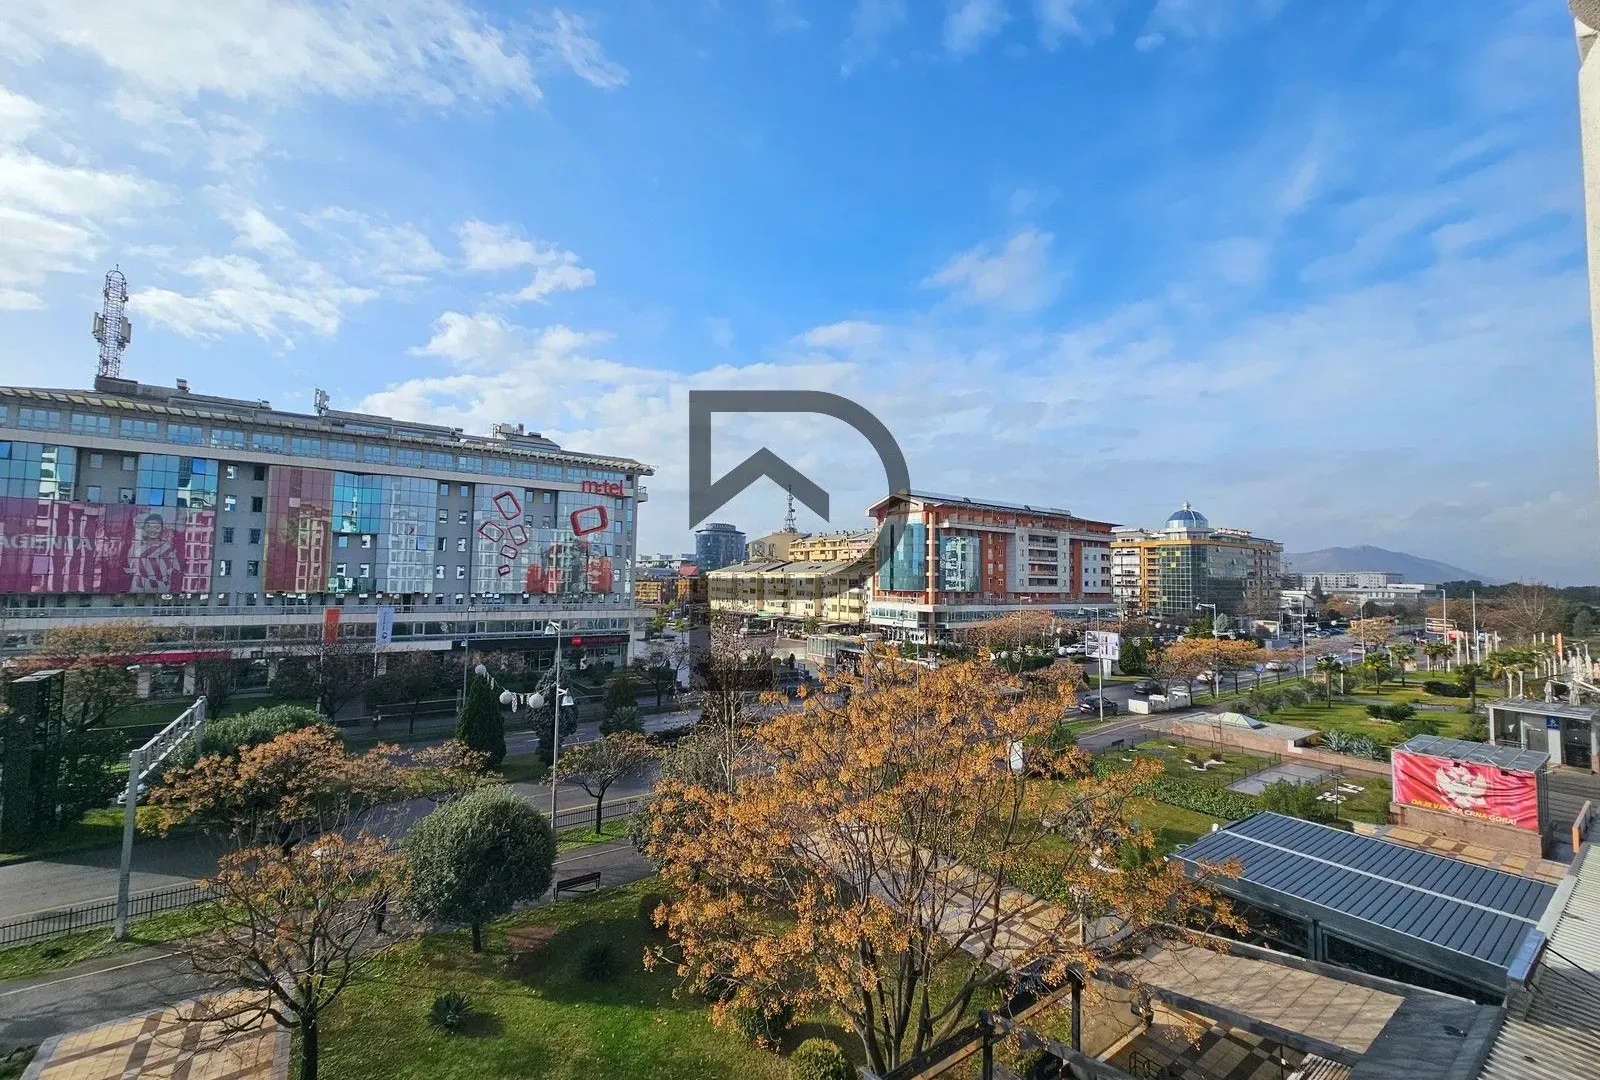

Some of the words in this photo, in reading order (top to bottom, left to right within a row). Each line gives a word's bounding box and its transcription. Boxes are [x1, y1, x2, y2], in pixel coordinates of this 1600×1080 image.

[582, 480, 623, 495] m:tel
[1464, 809, 1487, 819] CRNA
[1488, 814, 1517, 825] GORA!
